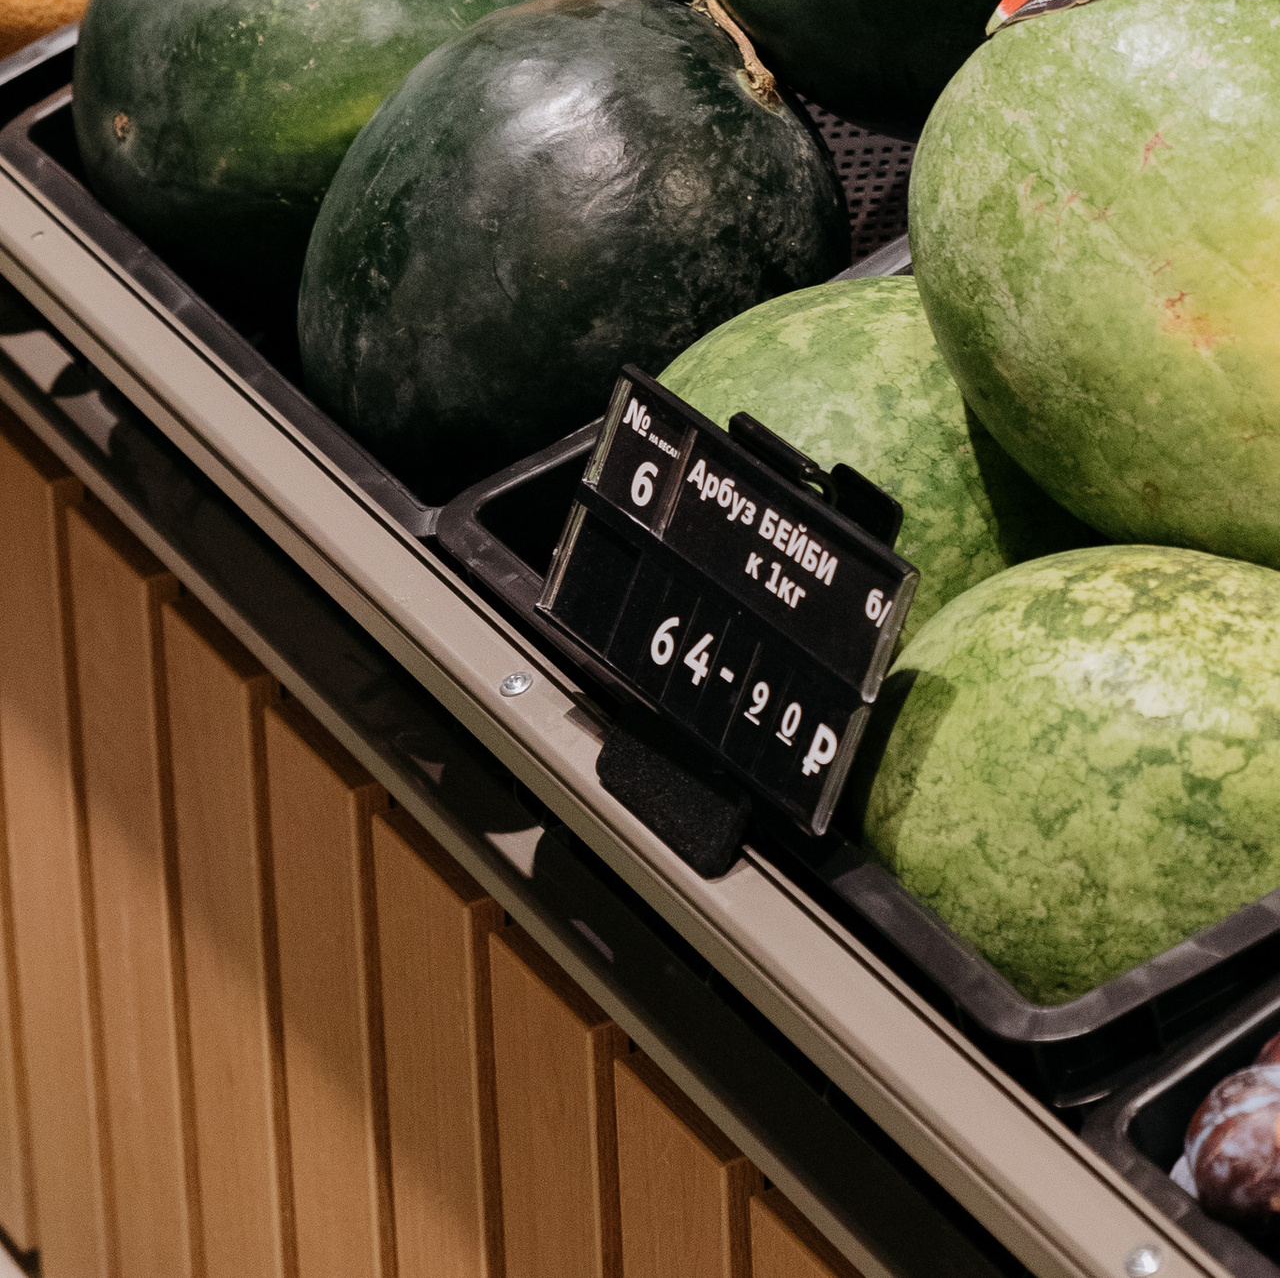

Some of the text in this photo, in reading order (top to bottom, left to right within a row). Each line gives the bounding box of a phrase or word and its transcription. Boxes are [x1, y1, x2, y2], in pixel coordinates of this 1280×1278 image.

[622, 397, 652, 438] №
[629, 460, 660, 508] 6
[685, 457, 839, 587] Арбуз БЕЙБИ
[744, 551, 763, 582] к
[764, 561, 806, 610] 1кг
